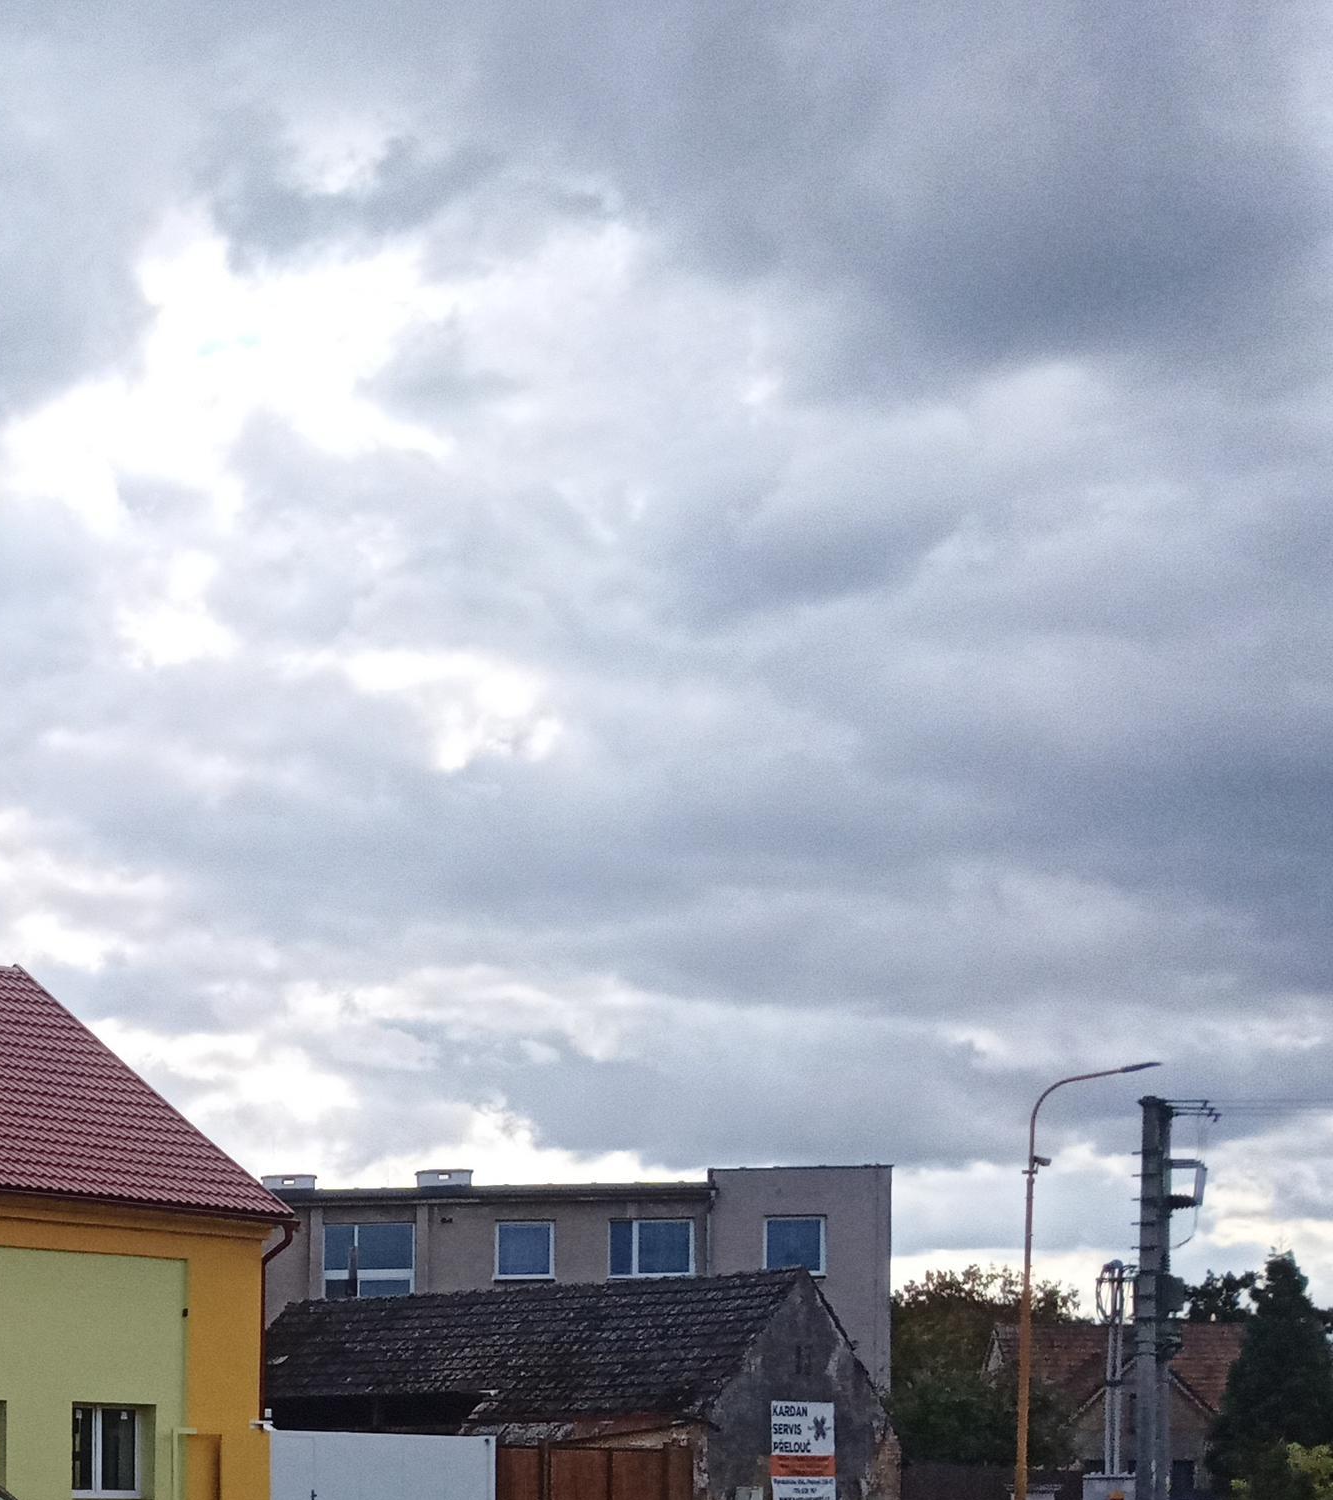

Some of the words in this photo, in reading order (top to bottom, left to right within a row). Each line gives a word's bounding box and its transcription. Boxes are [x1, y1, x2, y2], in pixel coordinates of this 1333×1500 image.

[773, 1405, 808, 1417] KARDAN
[773, 1423, 802, 1435] SERVIS
[773, 1439, 811, 1453] PŘELOUČ
